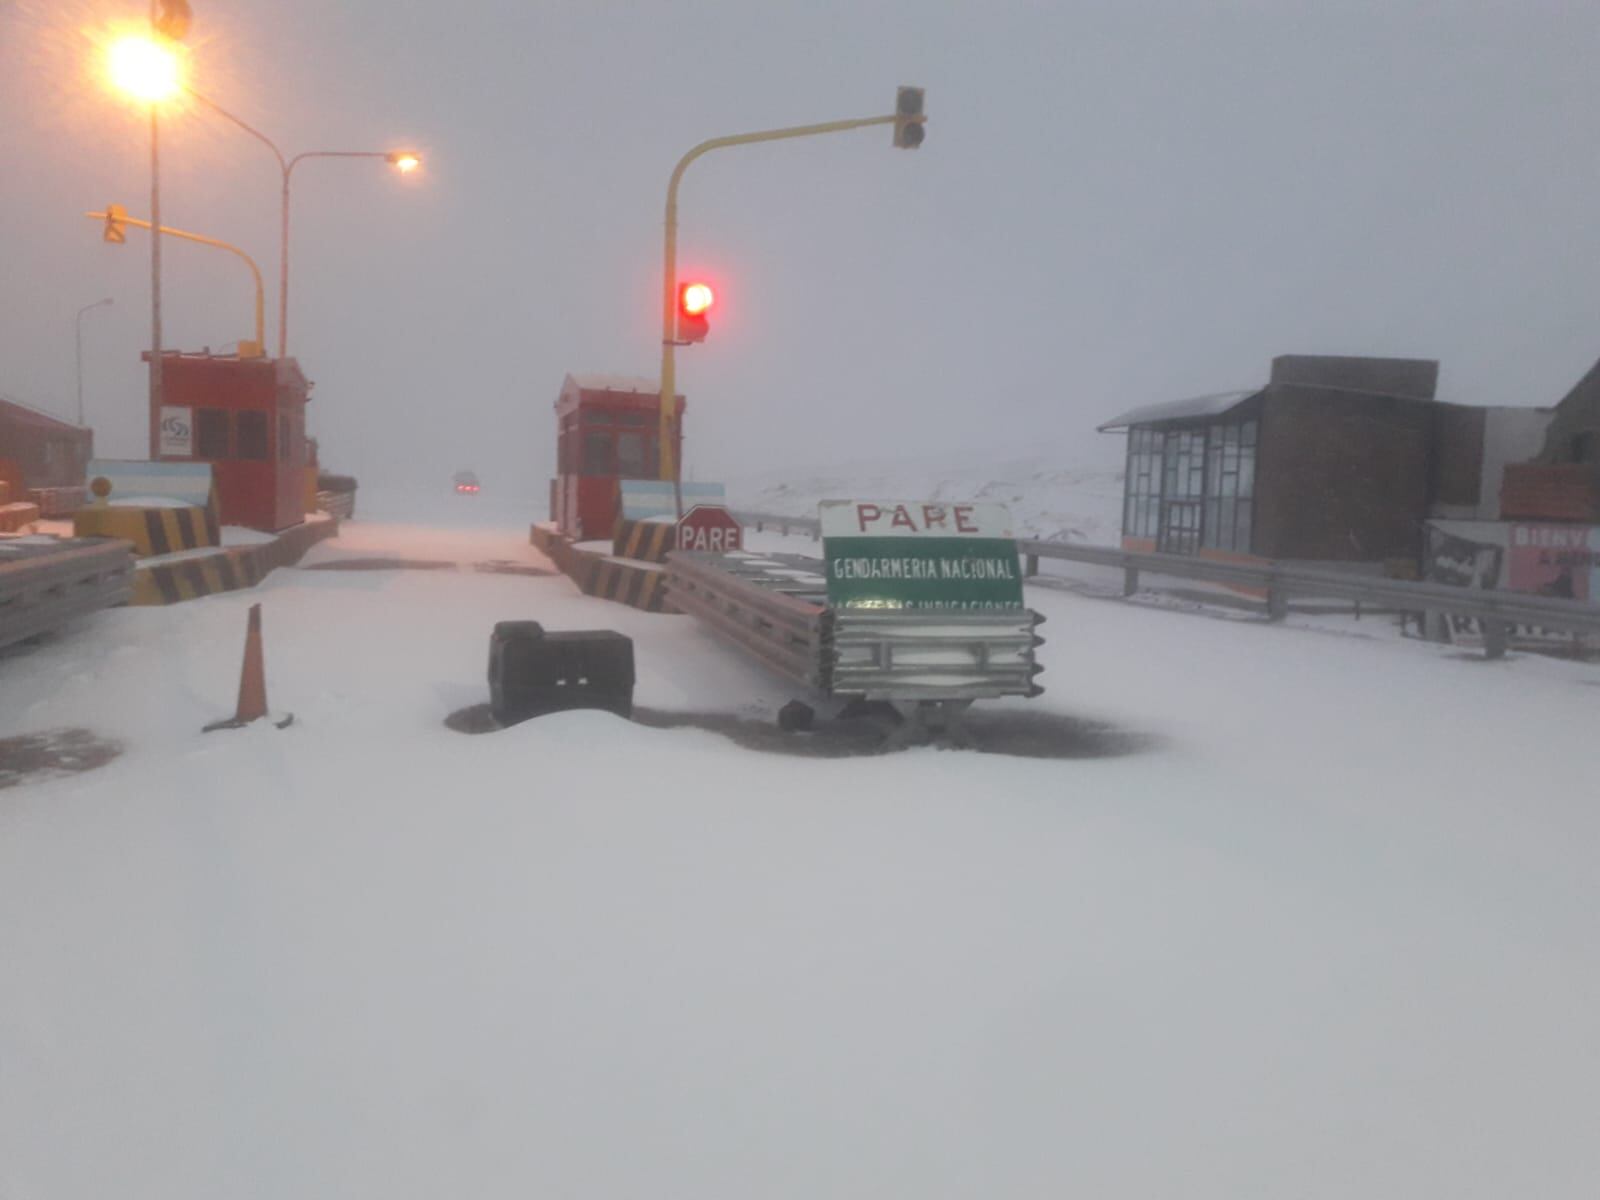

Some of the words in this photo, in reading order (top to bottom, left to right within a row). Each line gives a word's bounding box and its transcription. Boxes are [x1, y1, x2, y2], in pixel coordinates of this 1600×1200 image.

[857, 503, 979, 533] PARE
[682, 525, 738, 551] PARE
[833, 557, 938, 579] GENDARMERIA
[941, 557, 1015, 580] NACIONAL
